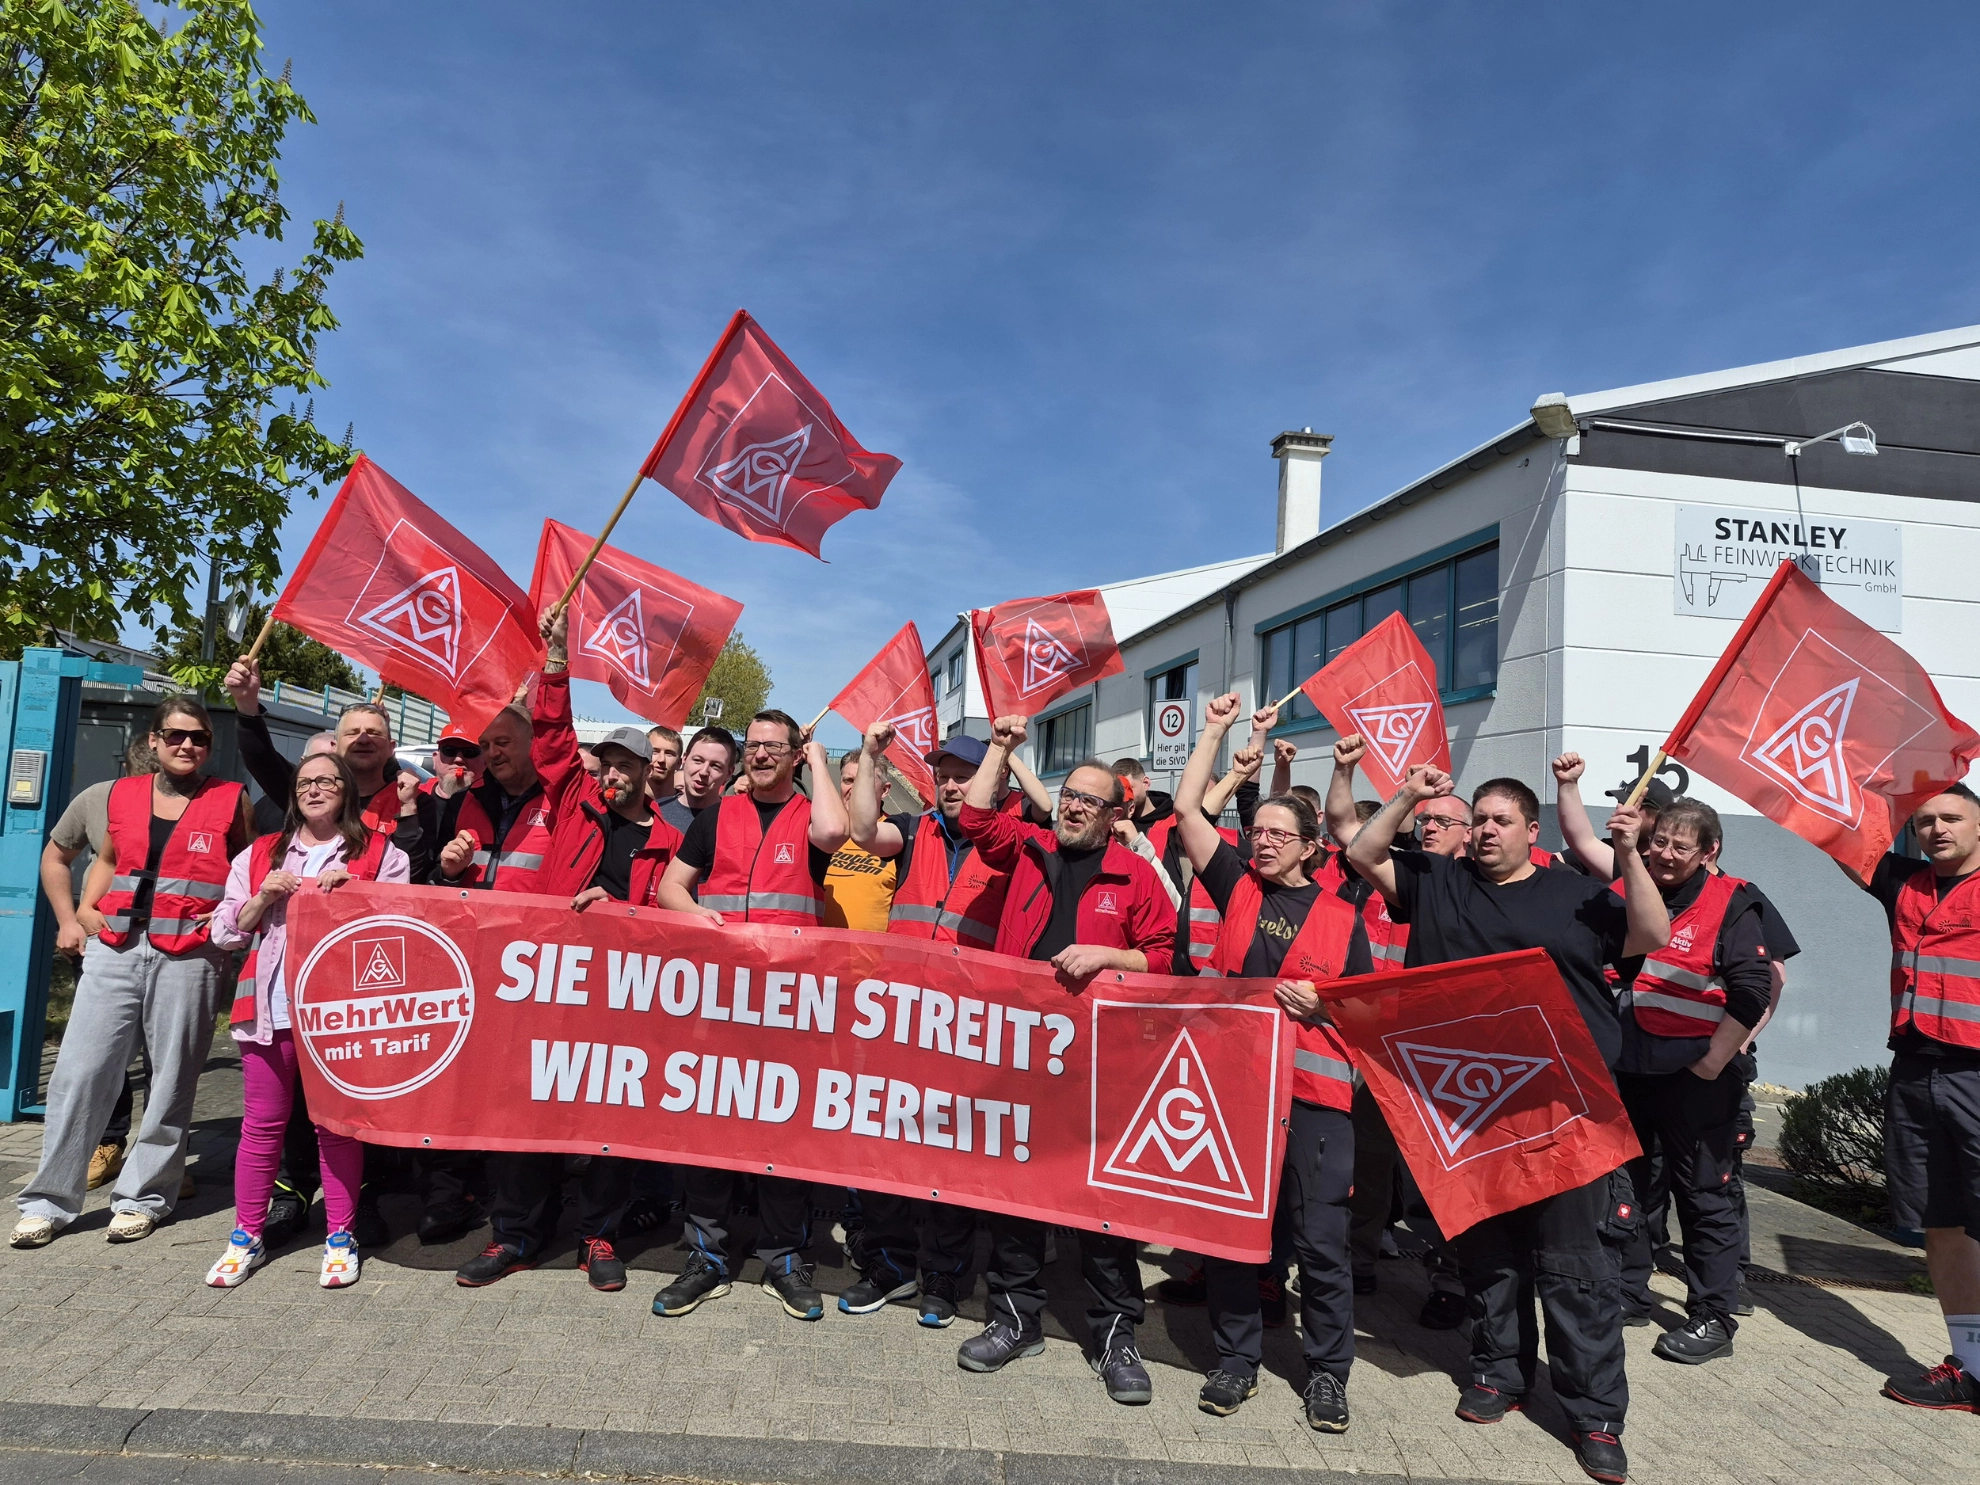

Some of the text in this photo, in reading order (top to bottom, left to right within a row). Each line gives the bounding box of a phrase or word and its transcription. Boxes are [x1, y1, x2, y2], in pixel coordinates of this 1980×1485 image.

[1714, 517, 1847, 549] STANLEY
[1714, 546, 1896, 577] FEINWERKTECHNIK
[1864, 582, 1897, 594] GmbH
[1166, 713, 1179, 728] 12
[1156, 756, 1187, 766] die StVO
[1157, 743, 1186, 754] Hier gilt
[1626, 745, 1689, 797] 15
[298, 992, 470, 1032] MehrWert
[495, 940, 1076, 1077] SIE WOLLEN STREIT?
[325, 1033, 431, 1061] mit Tarif
[531, 1038, 1031, 1163] WIR SIND BEREIT!
[1125, 1057, 1231, 1183] IGM
